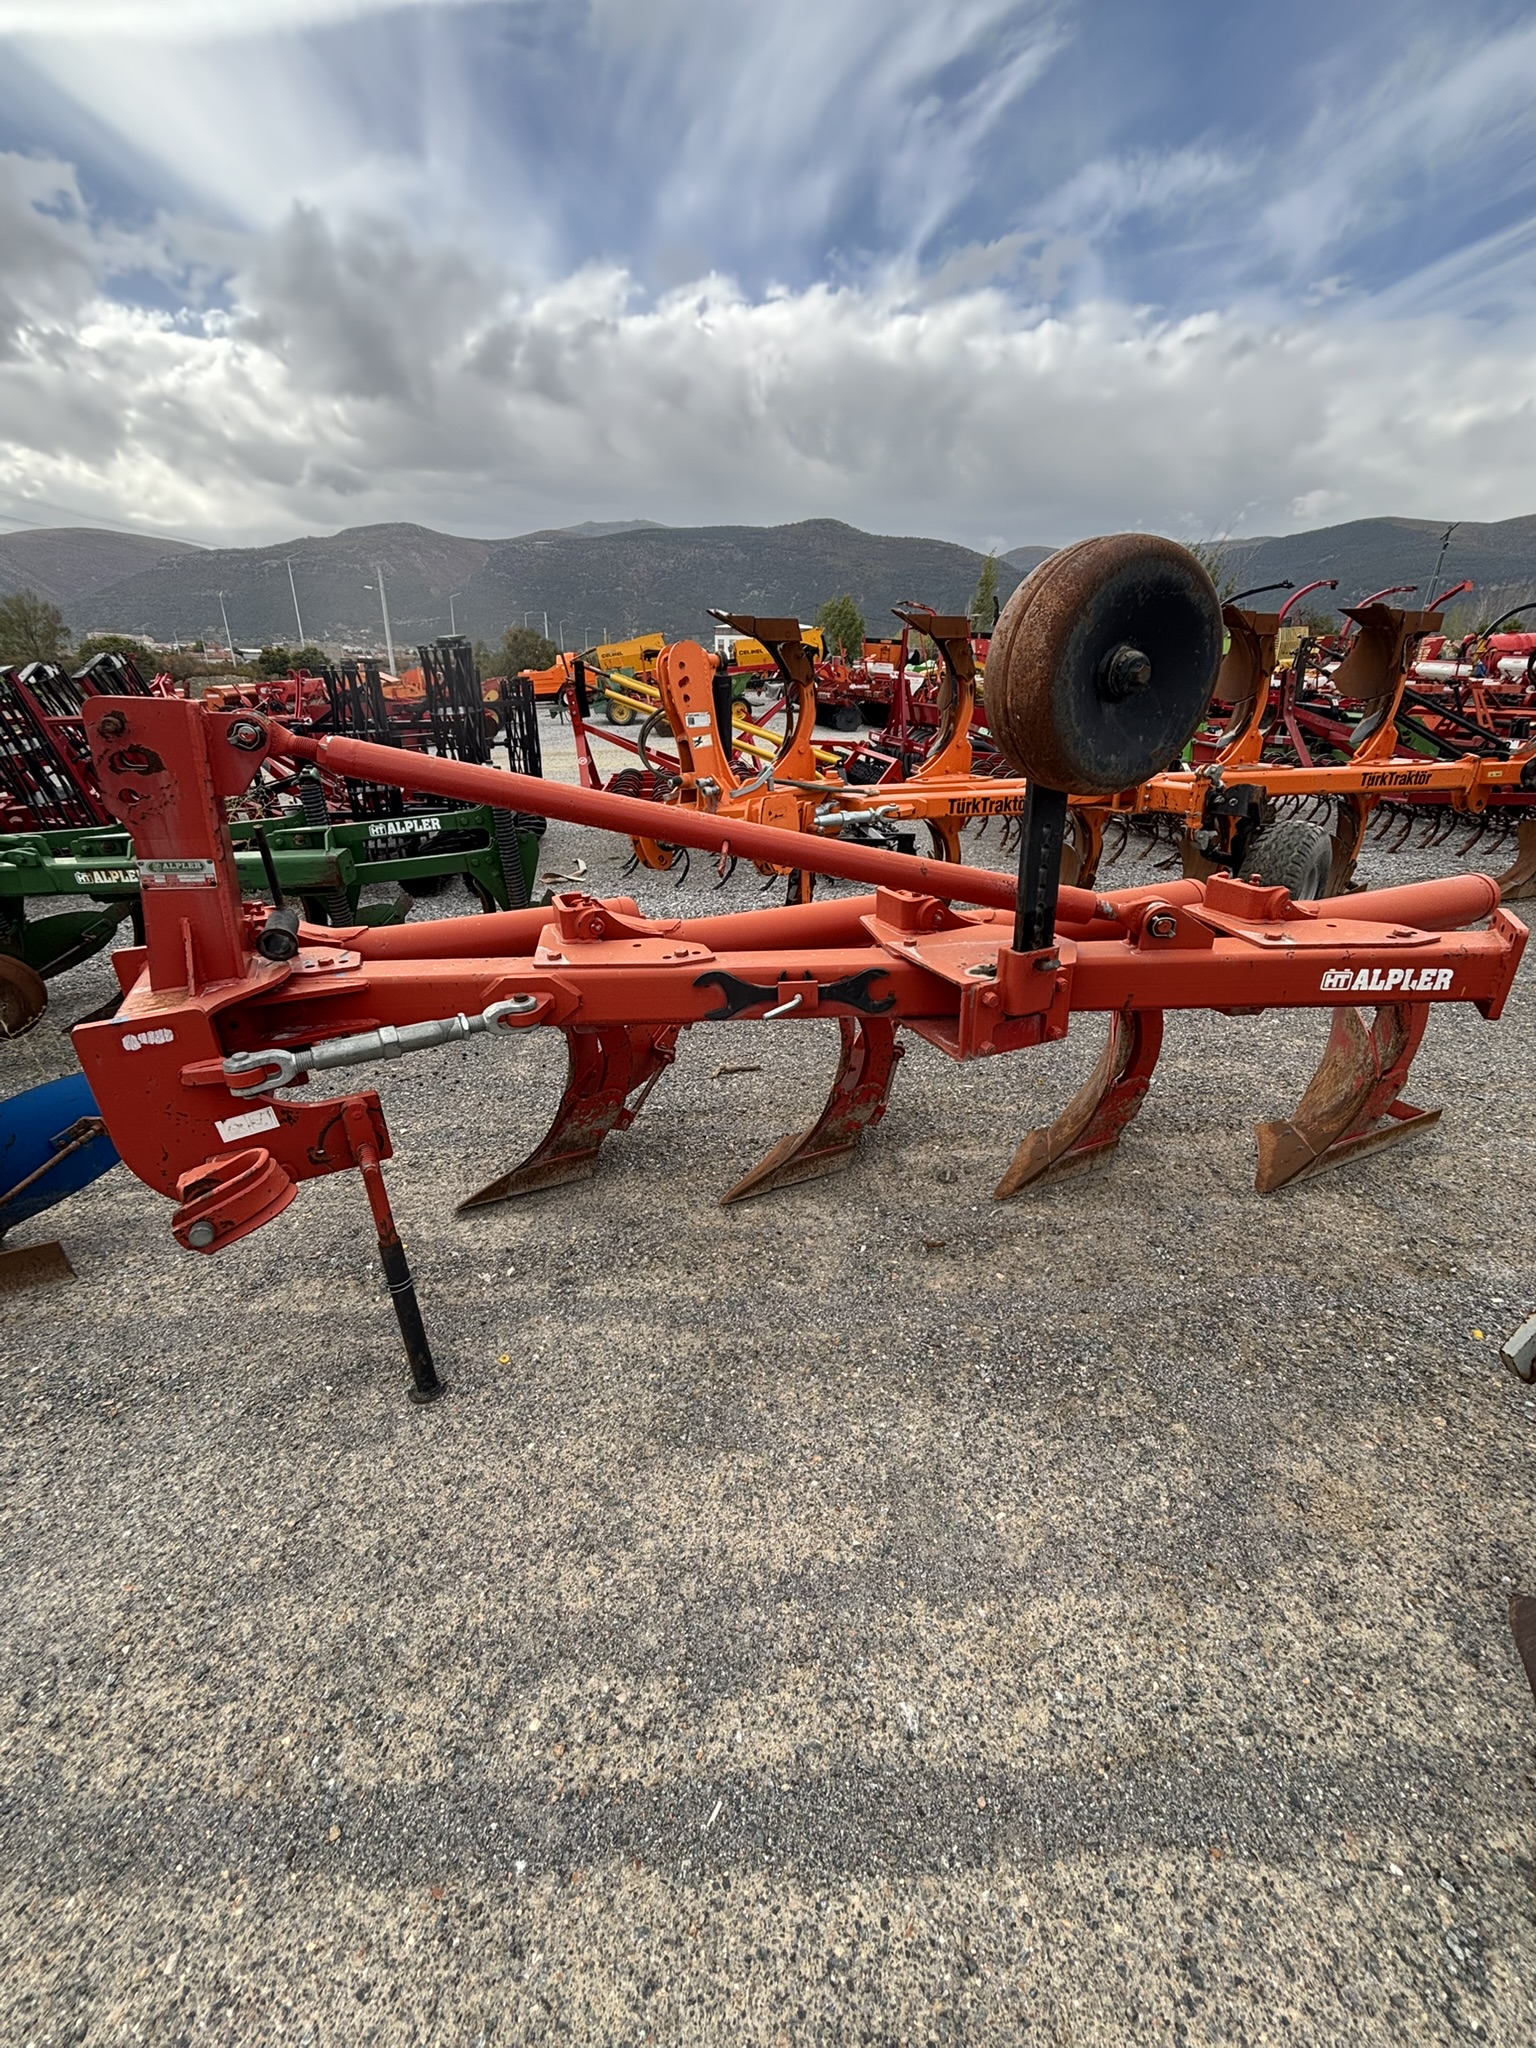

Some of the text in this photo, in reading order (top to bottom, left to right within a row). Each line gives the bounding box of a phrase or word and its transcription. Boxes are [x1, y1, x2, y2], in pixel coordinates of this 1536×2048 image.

[1361, 771, 1433, 786] TürkTraktör
[948, 796, 1025, 814] TürkTraktö
[388, 817, 441, 835] ALPLER
[93, 870, 139, 884] ALPLE
[1351, 968, 1454, 991] ALPLER
